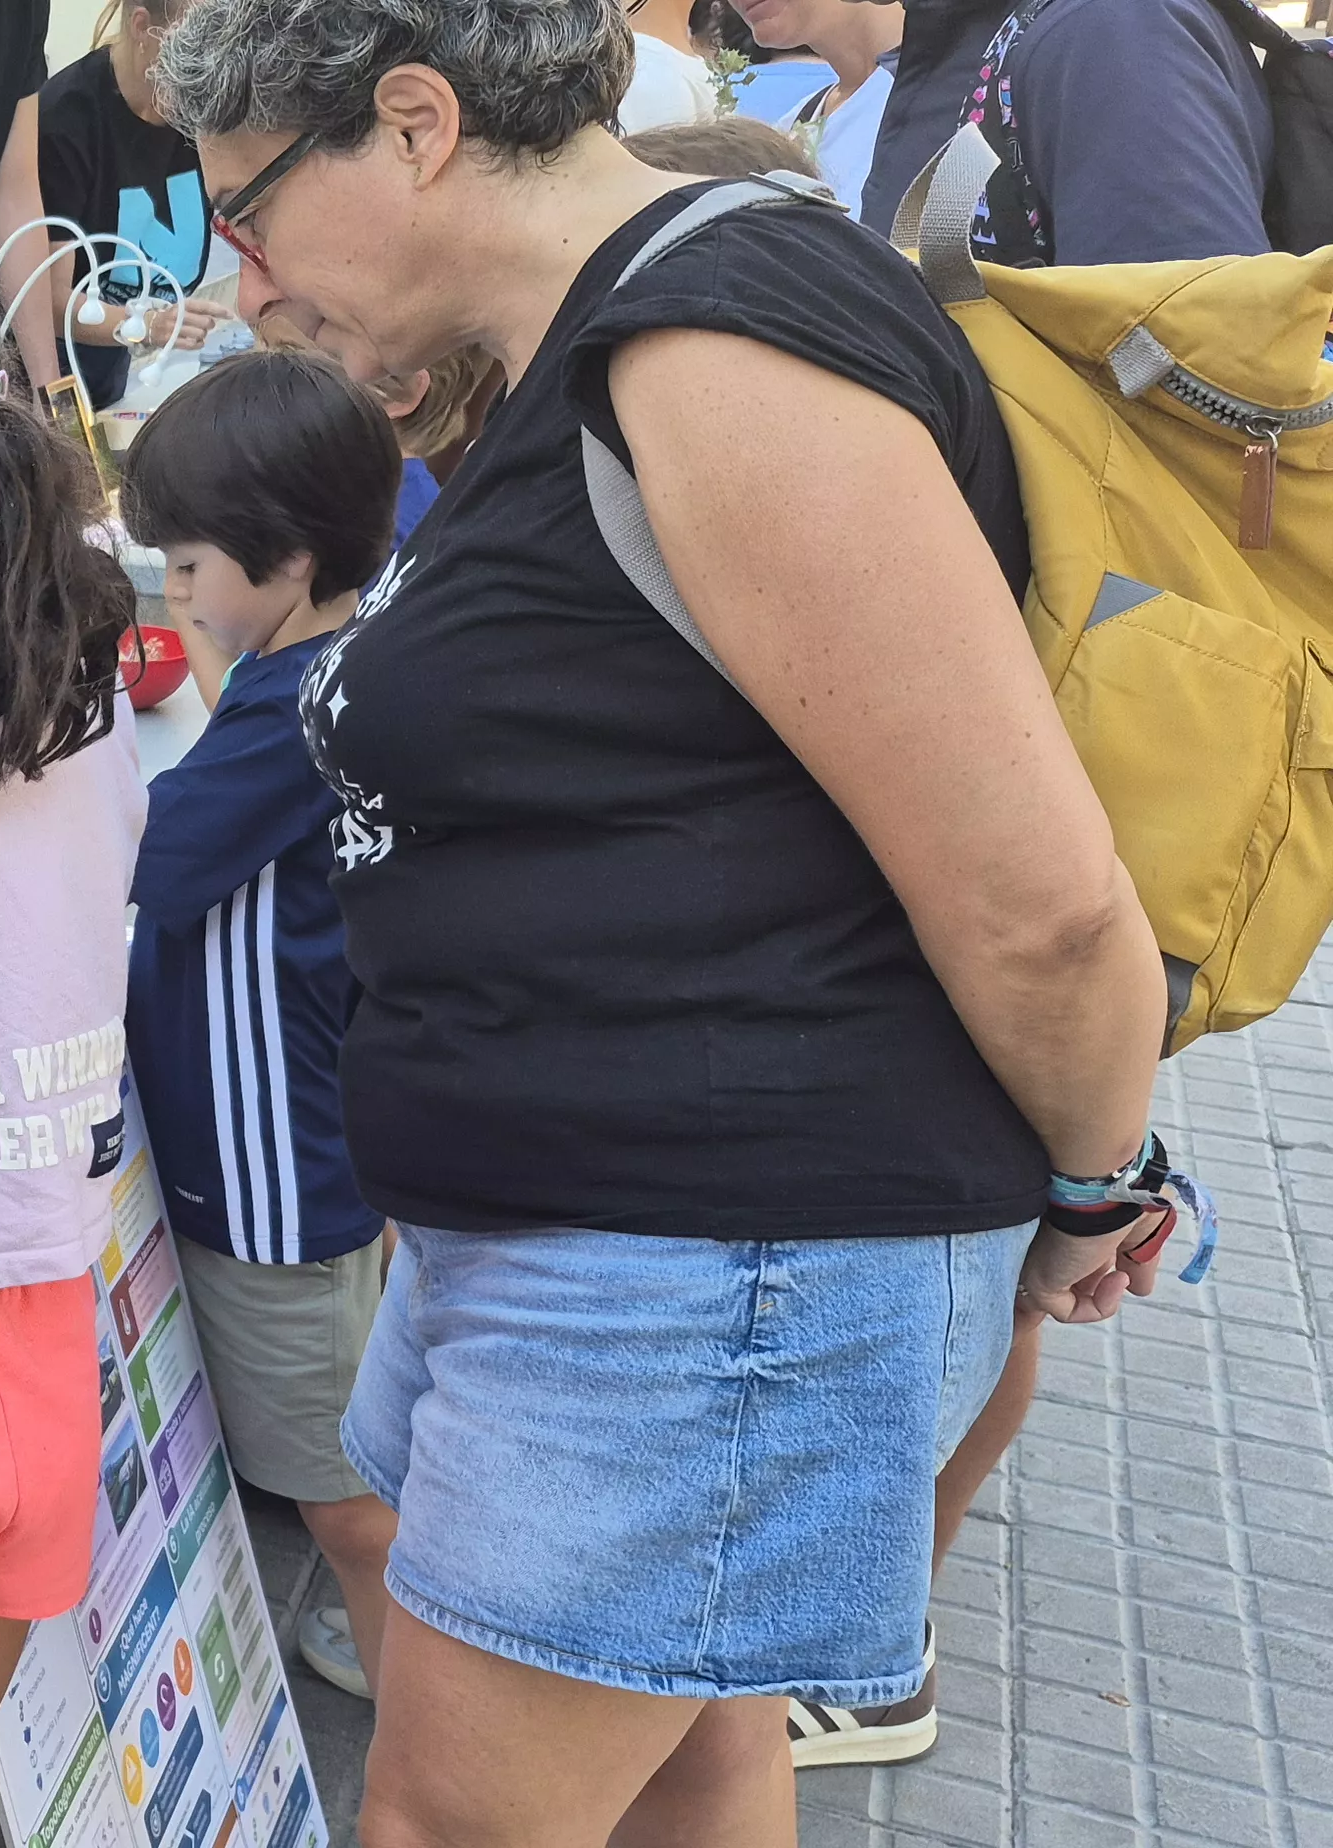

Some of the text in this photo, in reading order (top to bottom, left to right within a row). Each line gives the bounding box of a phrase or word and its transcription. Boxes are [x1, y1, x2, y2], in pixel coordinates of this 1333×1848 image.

[99, 1669, 108, 1692] 5
[41, 1722, 102, 1846] Topología resonante
